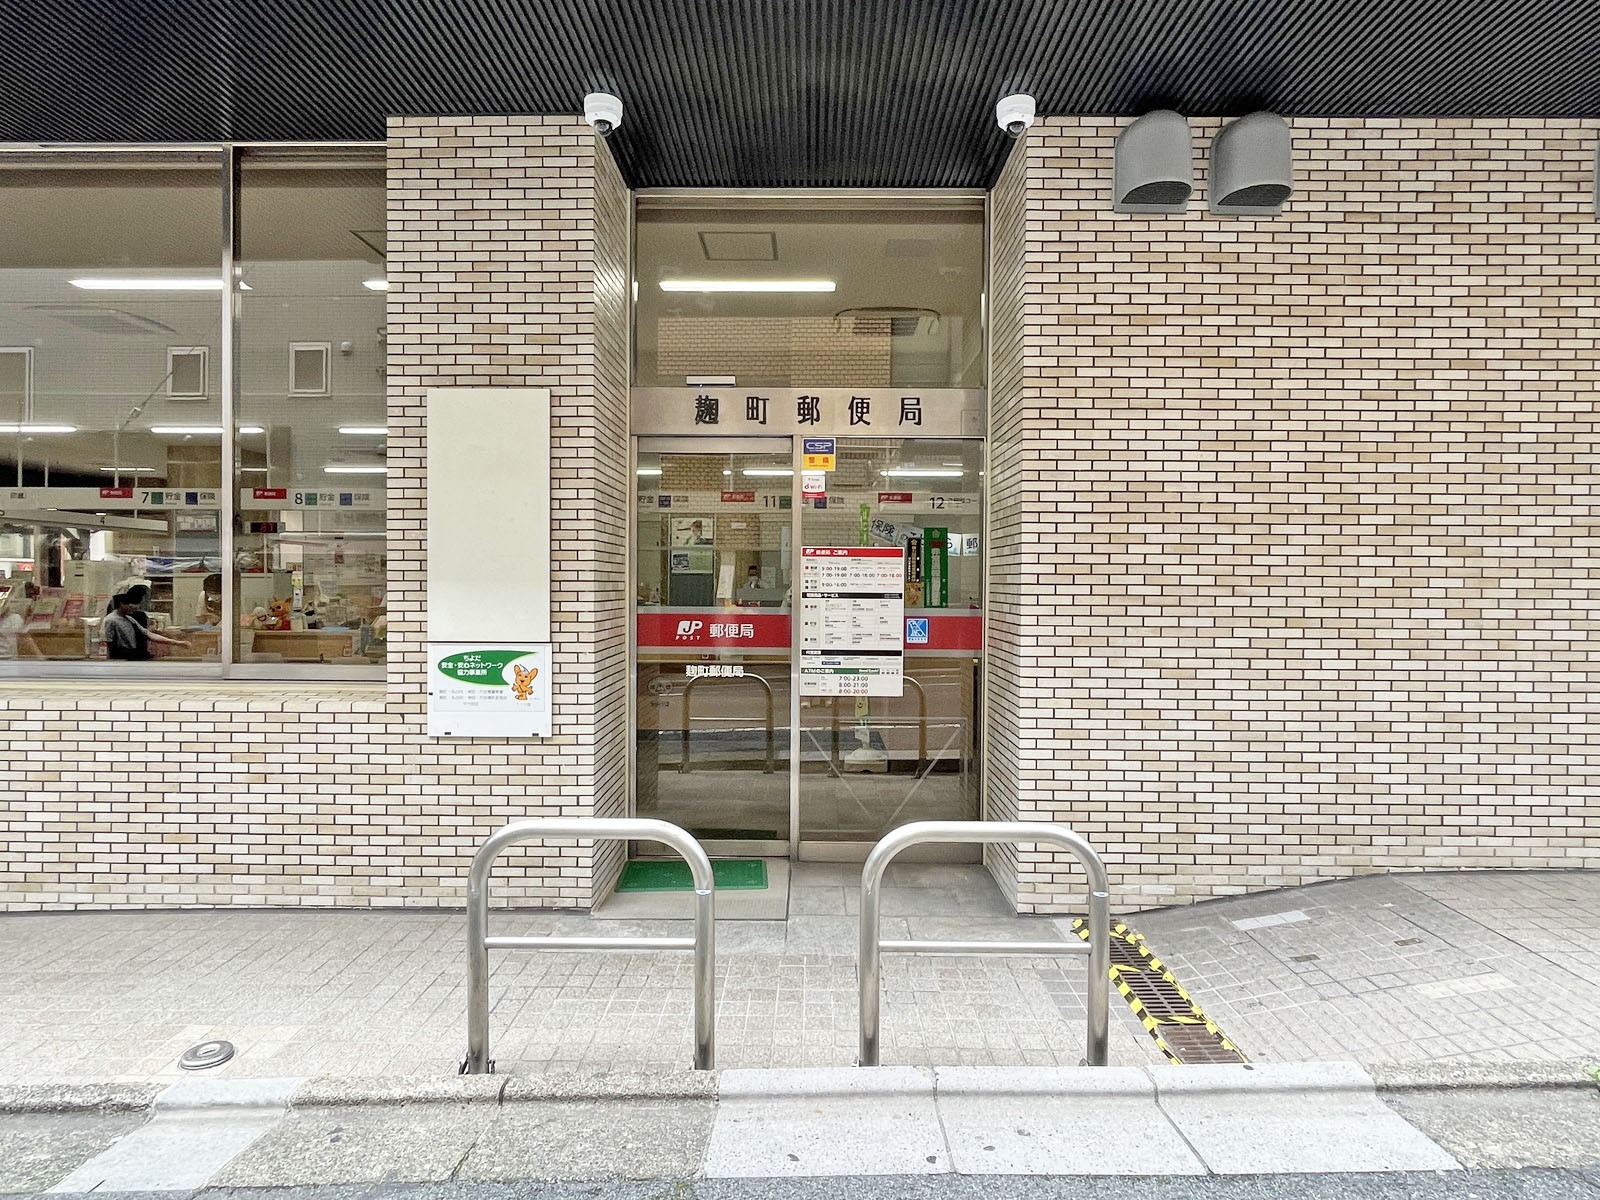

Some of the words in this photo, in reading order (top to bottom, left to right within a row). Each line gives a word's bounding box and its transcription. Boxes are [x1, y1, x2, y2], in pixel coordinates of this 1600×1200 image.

[142, 492, 149, 503] 7
[295, 493, 303, 504] 8
[763, 495, 776, 508] 11
[930, 497, 944, 509] 12
[871, 518, 896, 537] 保険
[709, 623, 754, 639] 郵便局
